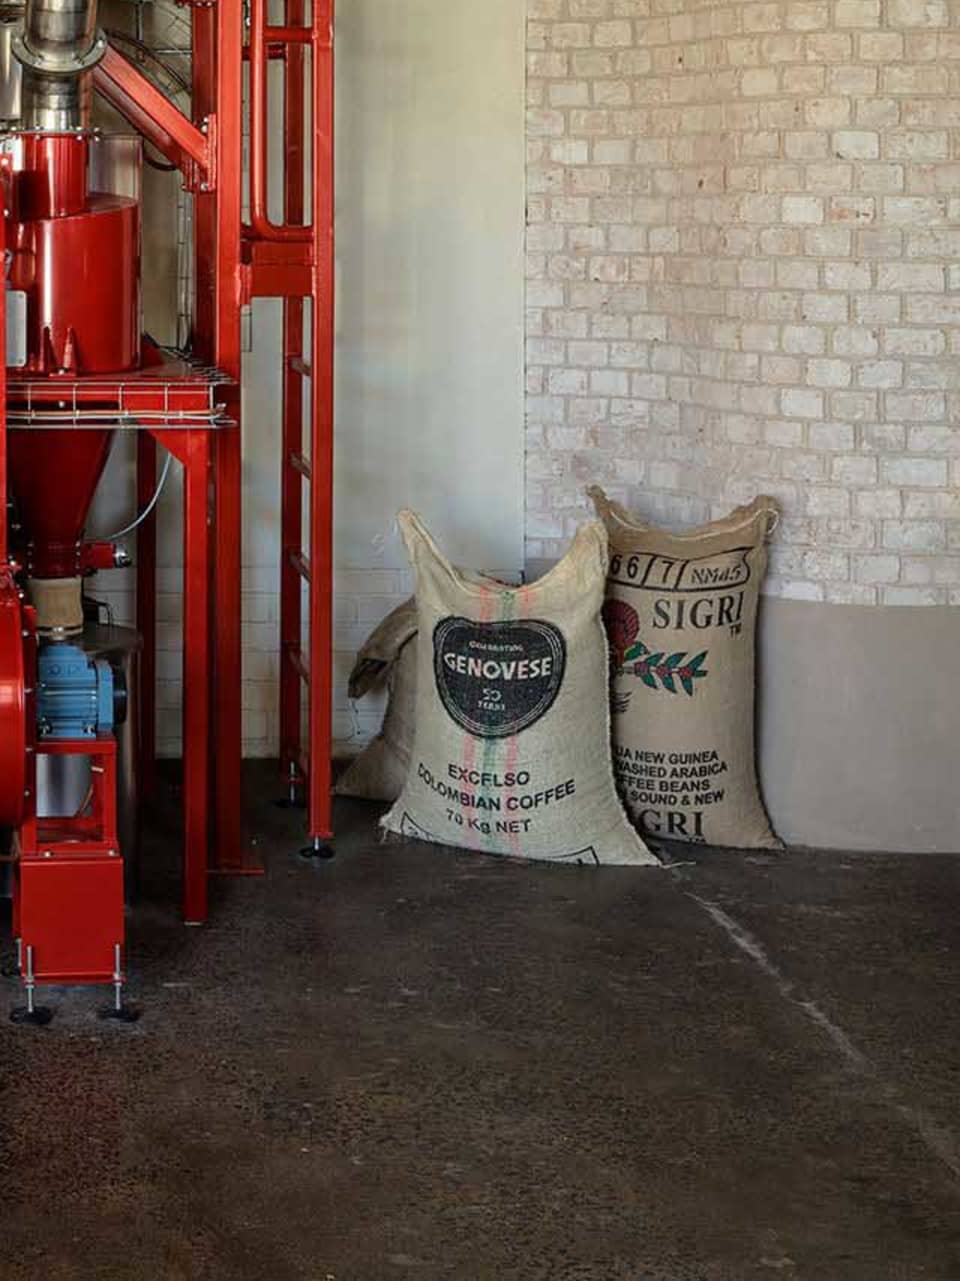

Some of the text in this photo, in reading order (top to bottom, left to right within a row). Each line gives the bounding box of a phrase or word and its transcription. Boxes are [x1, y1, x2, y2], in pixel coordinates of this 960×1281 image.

[652, 591, 744, 630] SIGRI
[443, 652, 553, 681] GENOVESE
[635, 750, 666, 764] NEW
[668, 750, 720, 765] GUINEA
[670, 761, 728, 779] ARABICA
[416, 762, 577, 812] COLOMBIAN COFFEE
[447, 762, 531, 787] EXCELSO
[659, 779, 711, 793] BEANS
[630, 790, 726, 806] SOUND & NEW
[445, 808, 533, 835] 70 Kg NET
